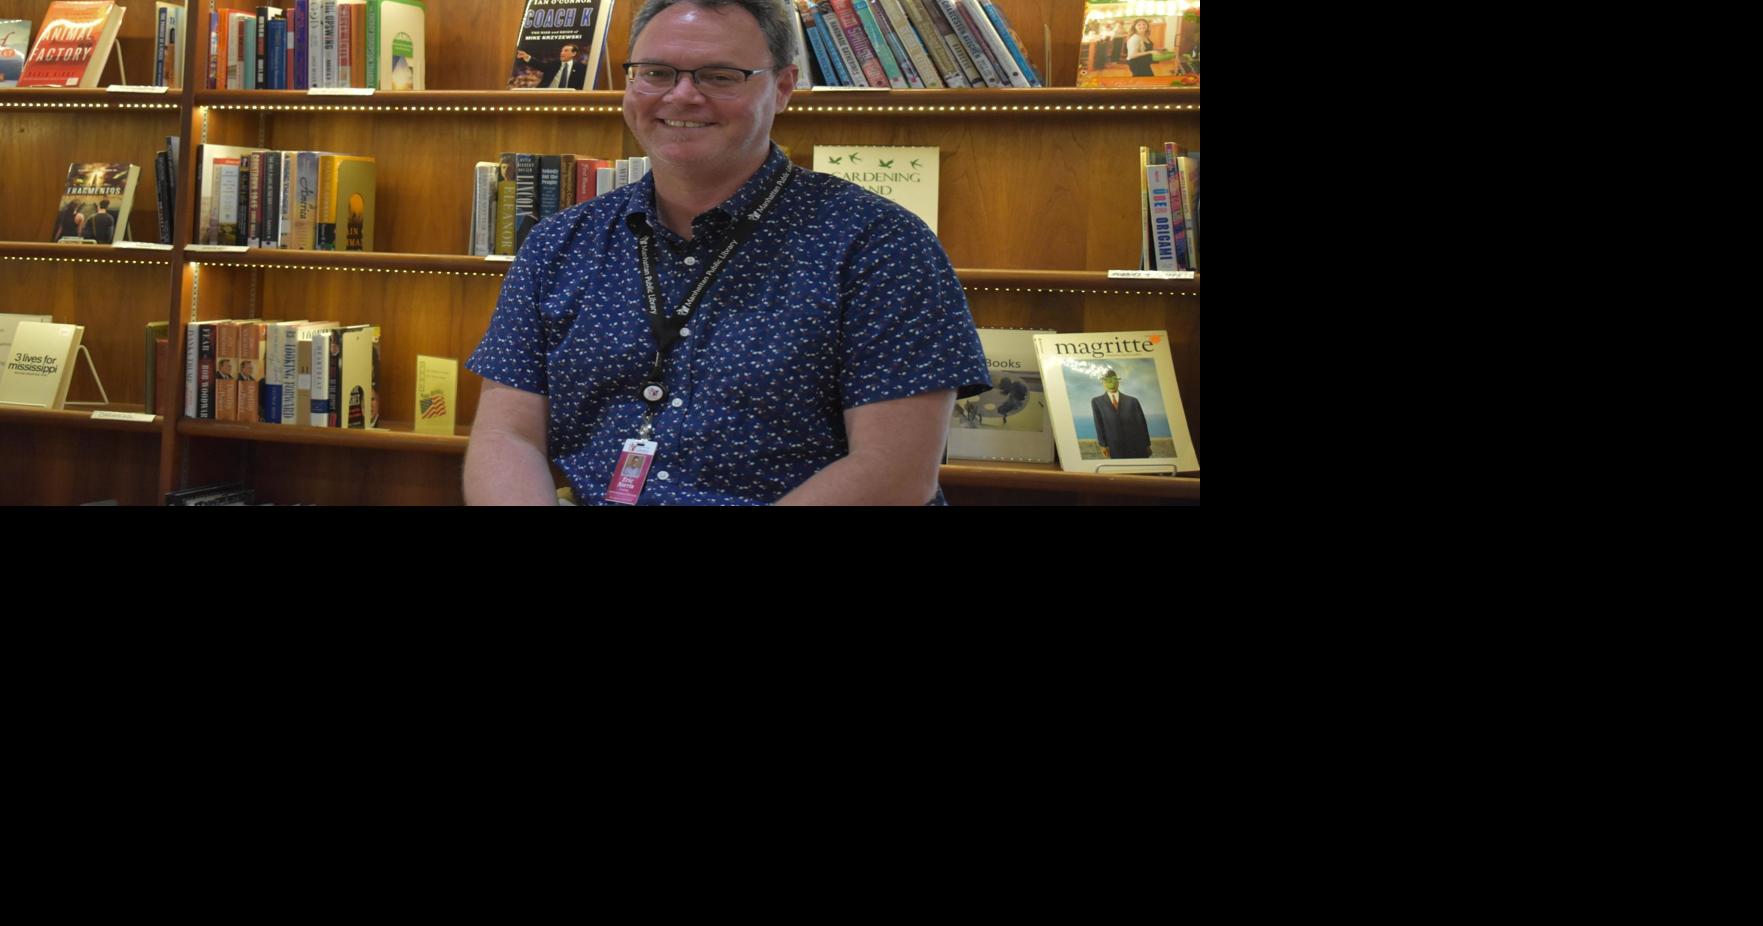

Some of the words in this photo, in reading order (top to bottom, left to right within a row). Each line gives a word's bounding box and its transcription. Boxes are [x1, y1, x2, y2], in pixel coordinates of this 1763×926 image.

[524, 8, 577, 28] COACH
[580, 8, 593, 27] K
[42, 26, 93, 40] ANIMAL
[325, 15, 335, 50] UPSWING
[29, 47, 92, 61] FACTORY
[847, 26, 874, 61] SPANISH
[832, 172, 920, 182] ARDENING
[67, 186, 121, 195] FRAGMENTOS
[250, 192, 258, 209] 1945
[756, 185, 781, 213] Manhattan
[776, 172, 790, 186] Public
[502, 186, 515, 247] ELEANOR
[1156, 217, 1173, 260] ORIGAMI
[641, 245, 650, 276] Manhattan
[684, 276, 709, 307] Manhattan
[705, 259, 722, 276] Public
[718, 239, 738, 259] Library
[645, 275, 655, 294] Public
[648, 294, 657, 315] Library
[202, 328, 211, 351] FEAR
[1055, 337, 1155, 358] magritte
[8, 362, 58, 374] mississippi
[14, 353, 22, 362] 3
[22, 353, 43, 363] lives
[43, 355, 57, 365] for
[284, 344, 296, 379] LOOKING
[201, 365, 209, 380] BOB
[200, 381, 209, 417] WOODWAR
[283, 381, 295, 419] FORWARD
